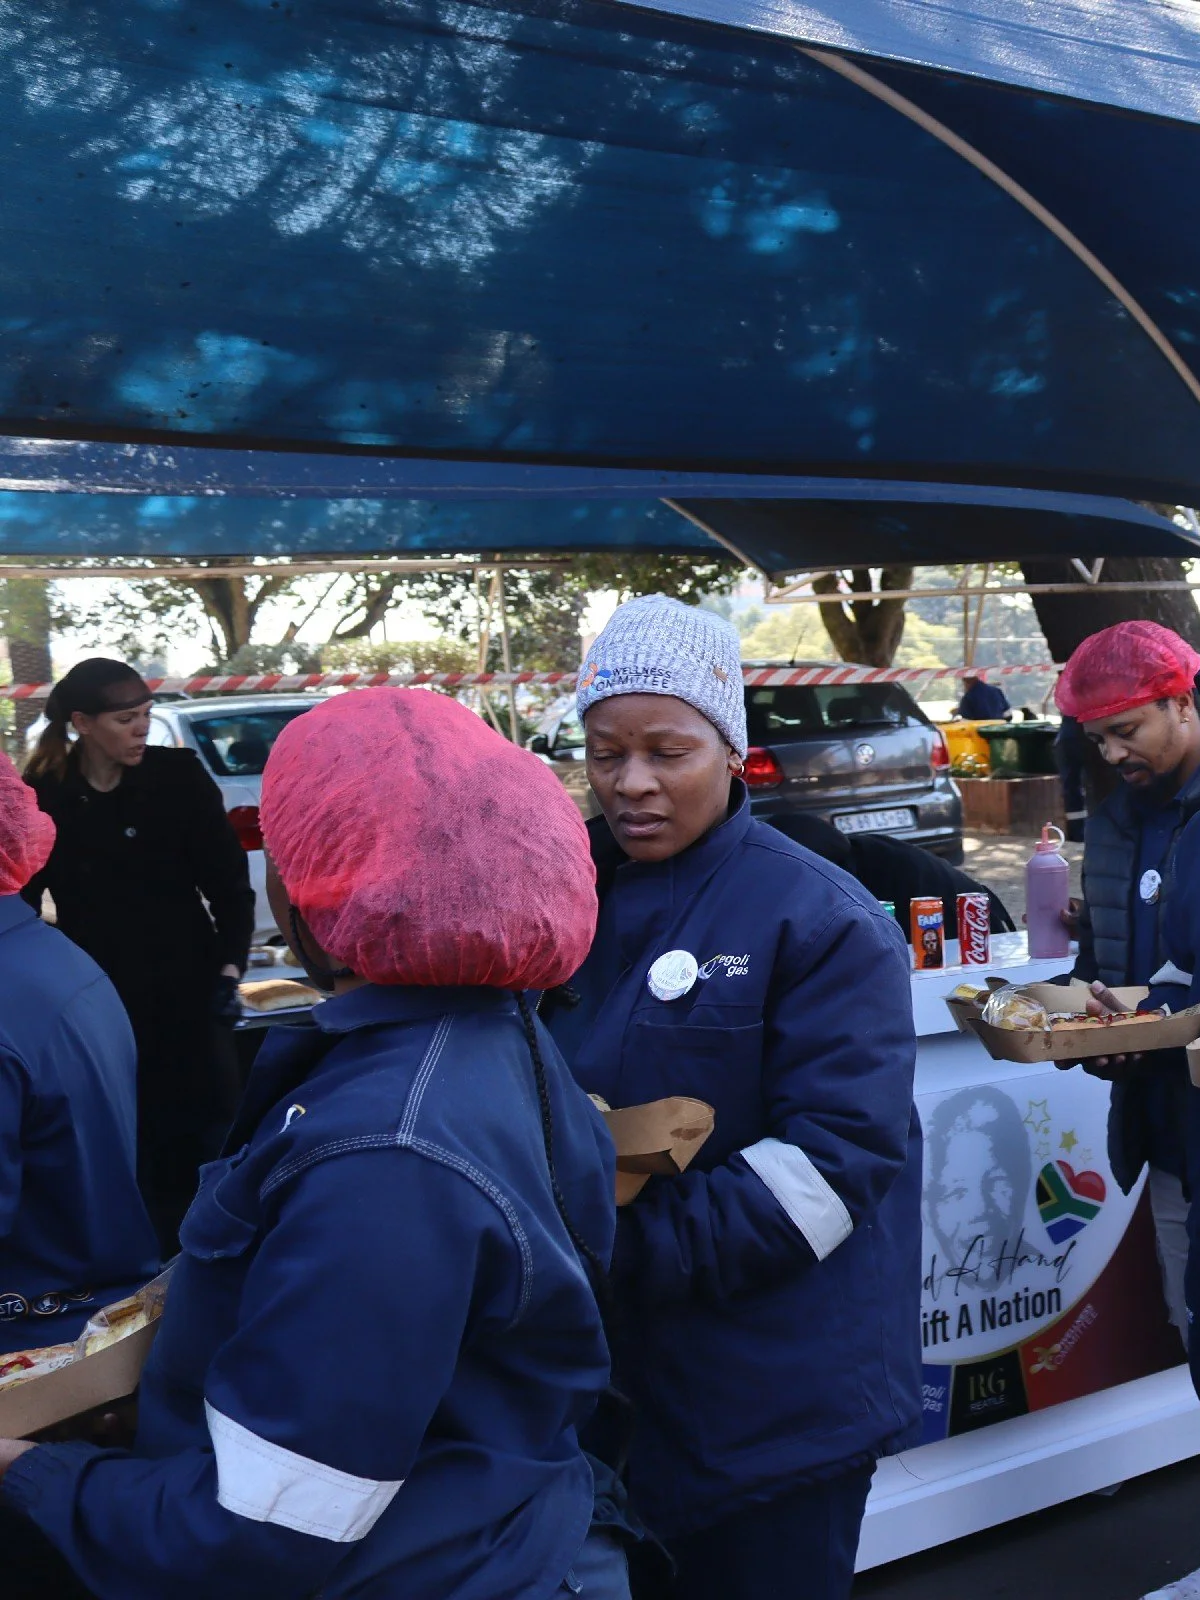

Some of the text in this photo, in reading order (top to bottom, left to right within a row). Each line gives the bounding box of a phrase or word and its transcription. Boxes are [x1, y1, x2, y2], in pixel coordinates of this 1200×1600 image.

[917, 912, 944, 927] FANT
[719, 953, 751, 969] egoli
[726, 965, 749, 978] gas
[987, 1228, 1077, 1284] Hand
[921, 1308, 950, 1348] ift
[957, 1303, 973, 1339] A
[980, 1286, 1062, 1333] Nation
[922, 1384, 946, 1400] goli
